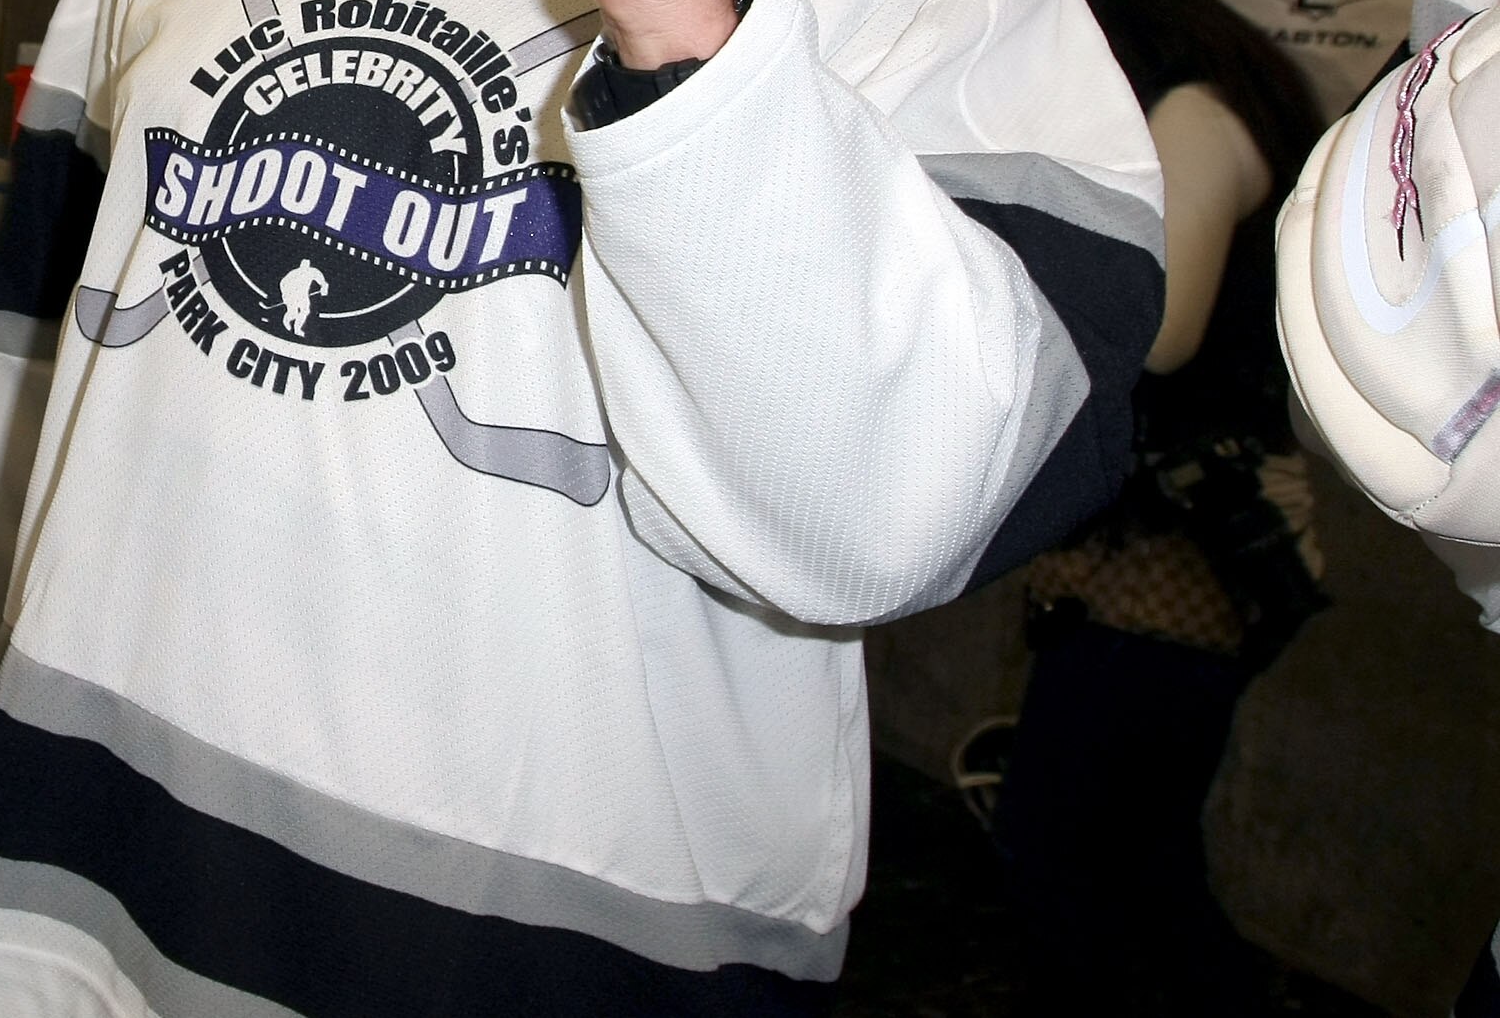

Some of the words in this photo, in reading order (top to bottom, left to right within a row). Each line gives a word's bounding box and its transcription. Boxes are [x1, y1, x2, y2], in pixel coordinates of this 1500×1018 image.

[190, 15, 285, 98] Luc
[1268, 29, 1379, 49] ASTON
[243, 49, 468, 156] CELEBRITY
[154, 148, 368, 231] SHOOT
[382, 187, 529, 272] OUT
[158, 249, 230, 356] PARK
[227, 337, 326, 401] CITY
[340, 330, 457, 402] 2009
